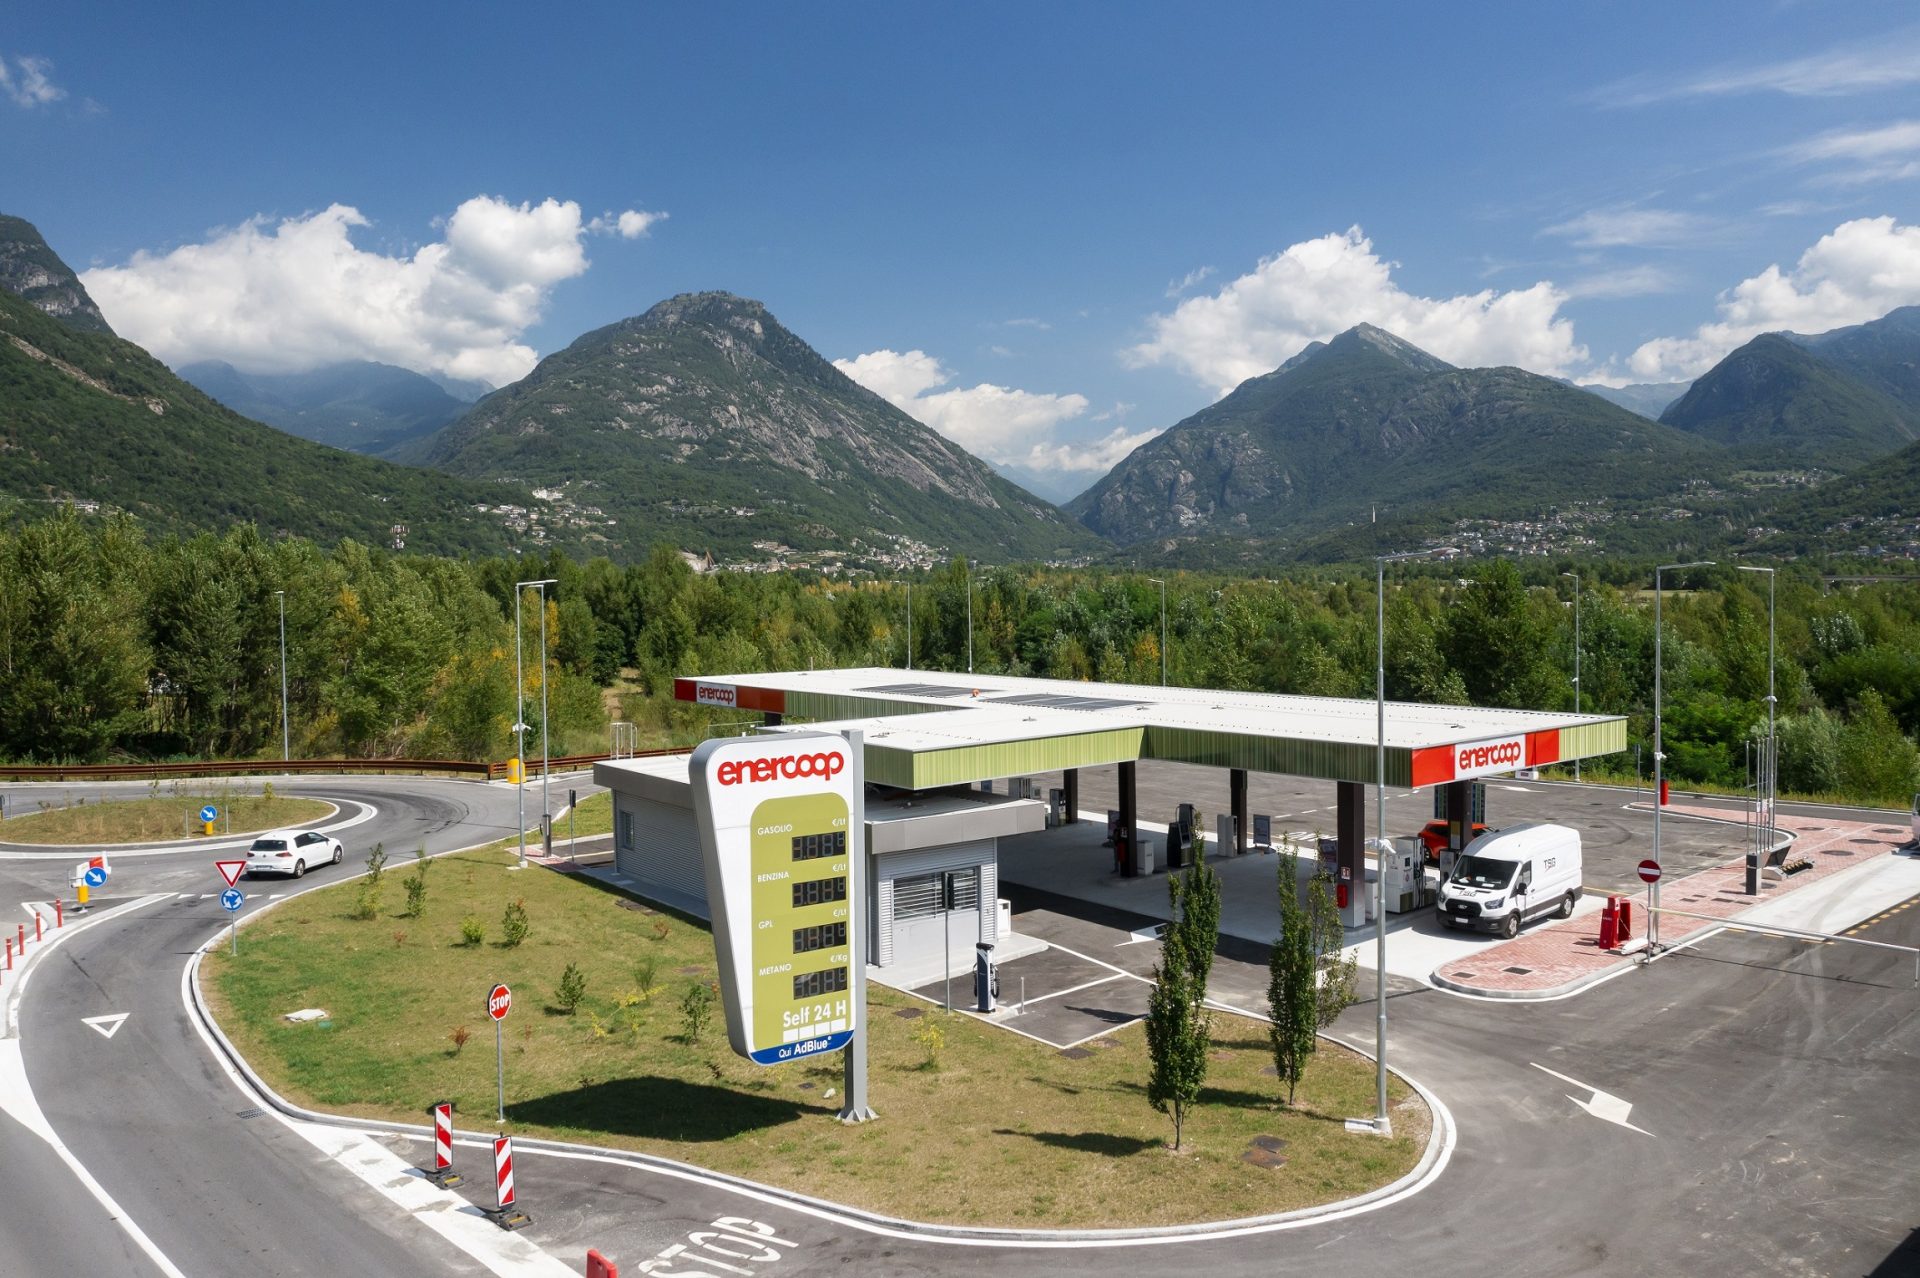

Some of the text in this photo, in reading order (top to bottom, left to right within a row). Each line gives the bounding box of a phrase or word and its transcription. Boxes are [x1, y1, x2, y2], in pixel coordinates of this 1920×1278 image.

[698, 686, 734, 704] enercoop
[1459, 741, 1521, 770] enercoop
[717, 751, 844, 786] enercoop
[757, 824, 793, 836] GASOLIO
[757, 871, 790, 883] BENZINA
[758, 920, 774, 929] GPL
[759, 963, 792, 976] METANO
[491, 994, 510, 1011] STOP
[783, 999, 847, 1028] Self 24 H
[778, 1047, 792, 1058] Qui
